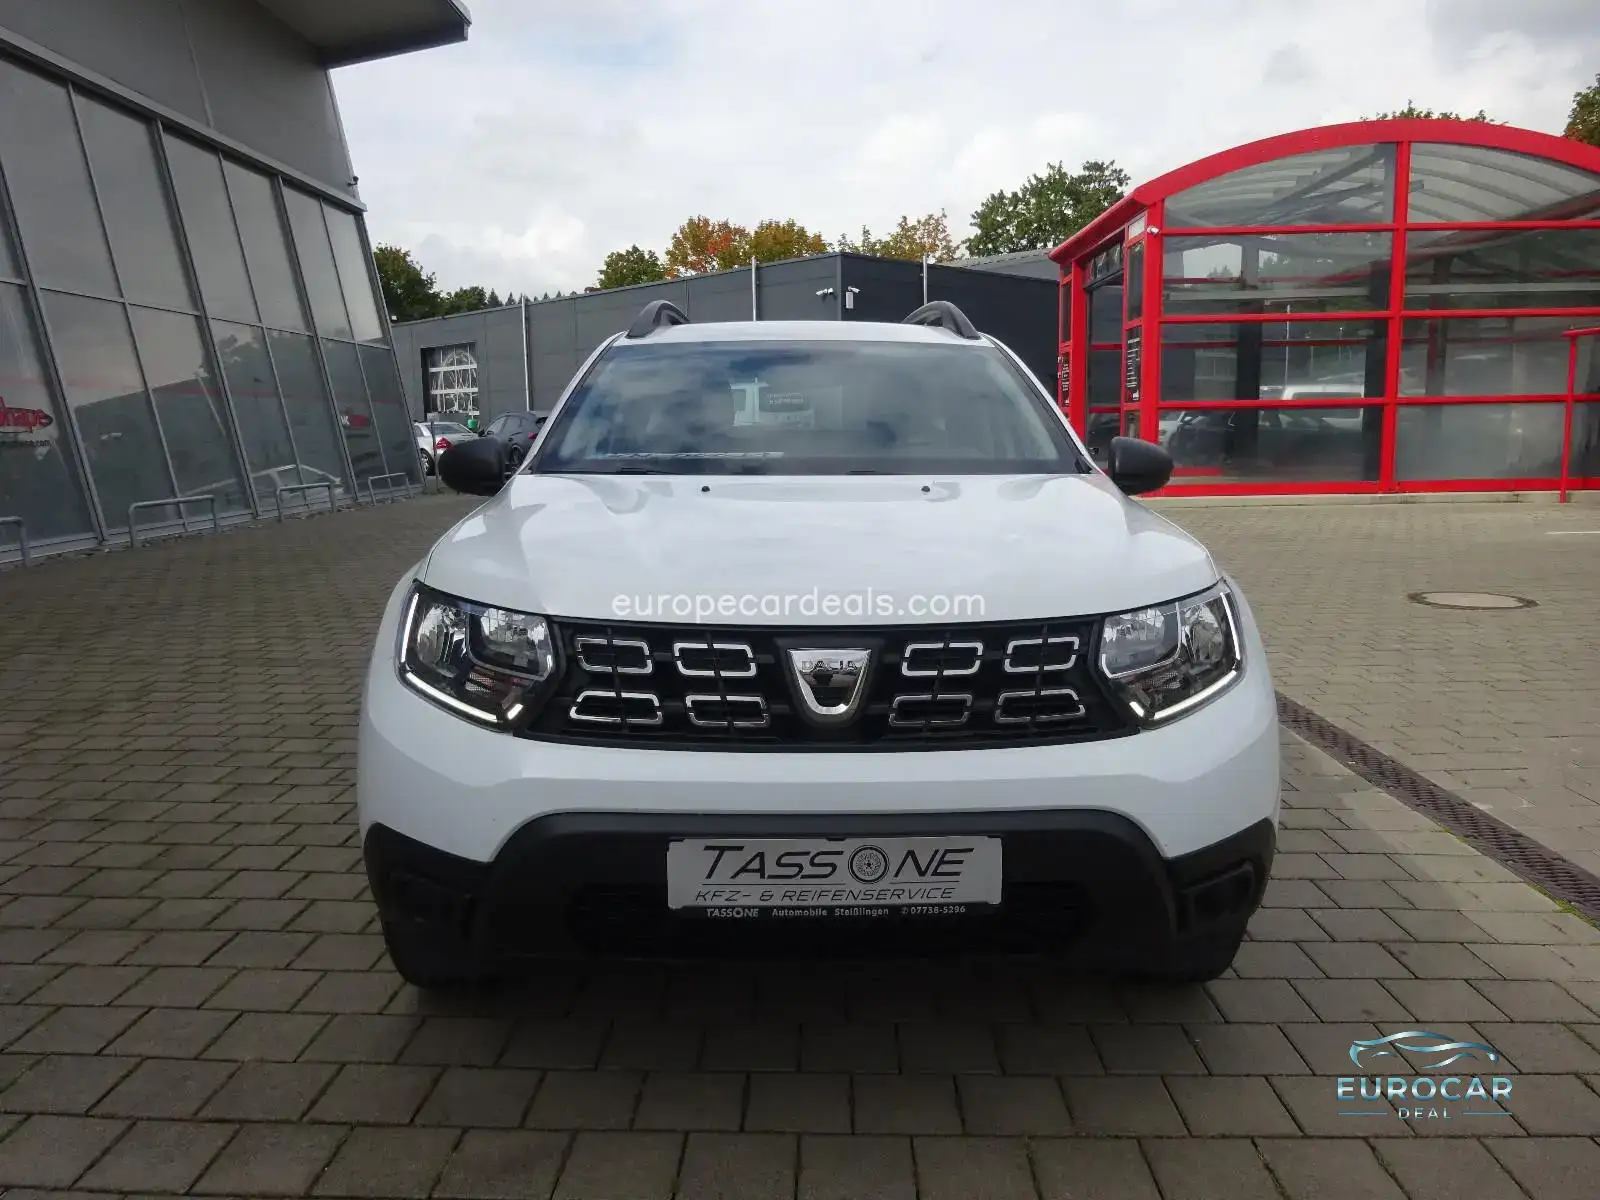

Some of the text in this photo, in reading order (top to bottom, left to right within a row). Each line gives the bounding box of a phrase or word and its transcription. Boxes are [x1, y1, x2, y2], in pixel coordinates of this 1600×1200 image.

[703, 844, 975, 885] TASSONE
[695, 887, 957, 902] KFZ- & REIFENSERVICE
[706, 907, 759, 918] TASSONE
[772, 907, 828, 917] Automobile
